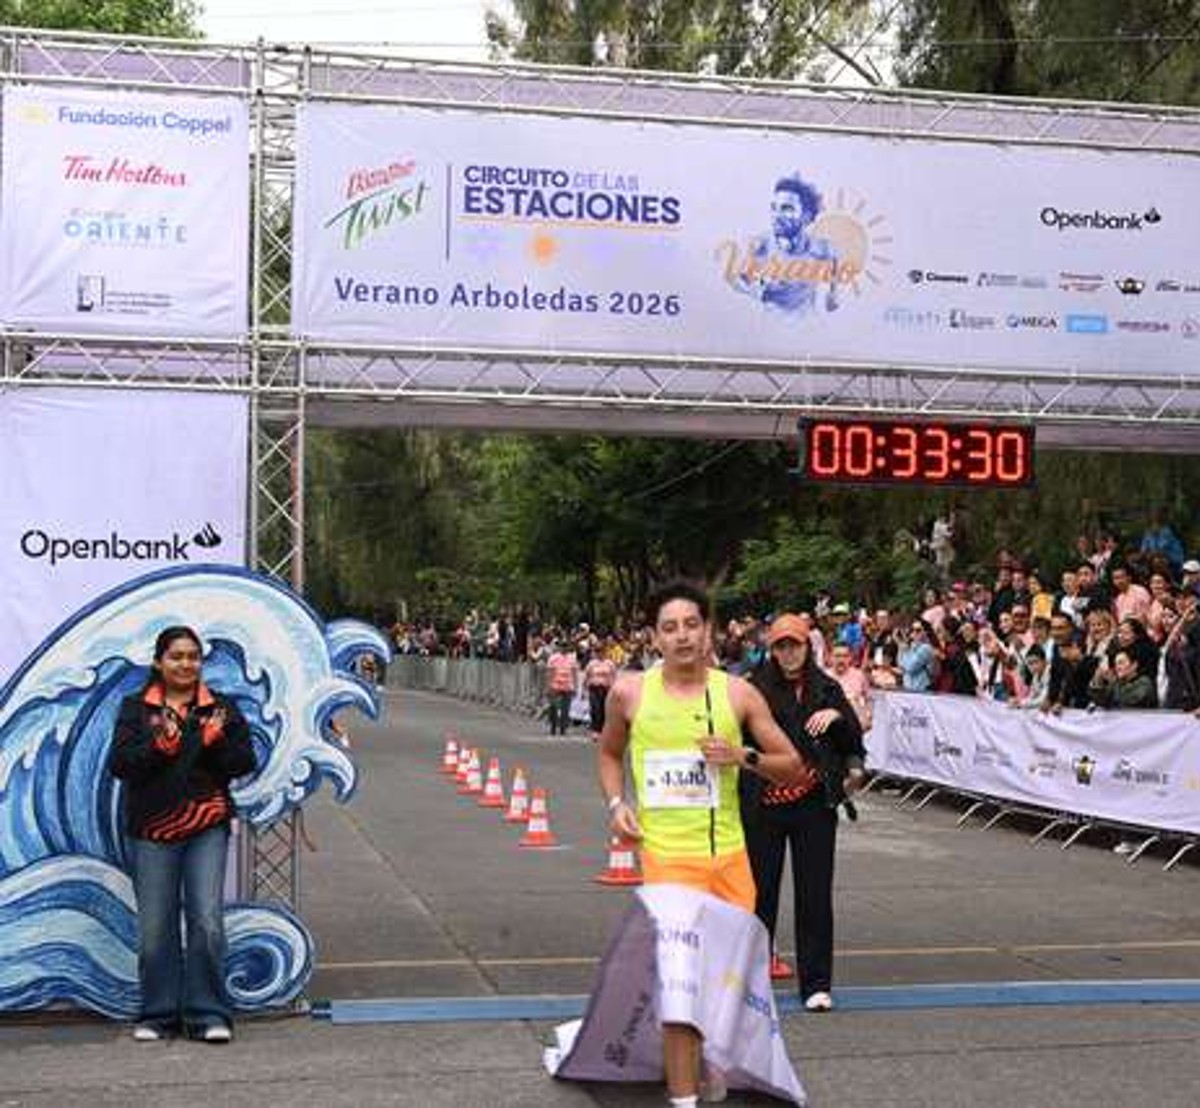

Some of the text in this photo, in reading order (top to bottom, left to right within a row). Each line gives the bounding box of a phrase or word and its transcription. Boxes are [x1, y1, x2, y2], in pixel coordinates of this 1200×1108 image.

[58, 106, 232, 135] Fundación Coppel
[64, 155, 187, 187] Tim Hortons
[463, 165, 638, 191] CIRCUITO DE LAS
[463, 185, 681, 224] ESTACIONES
[1040, 207, 1143, 231] Openbank
[334, 277, 681, 315] Verano Arboledas 2026
[812, 425, 1024, 479] 00:33:30
[20, 529, 190, 566] Openbank
